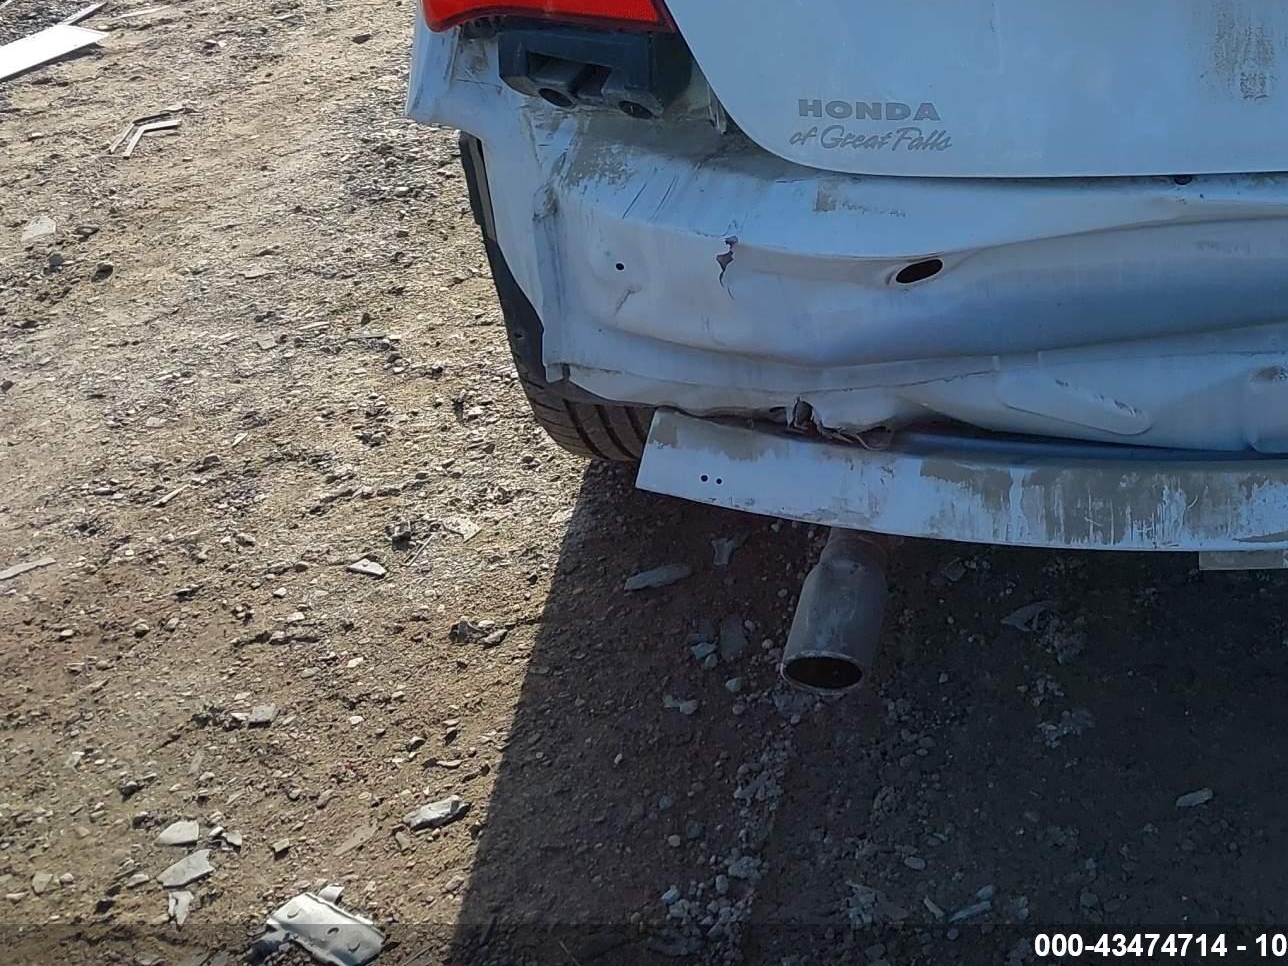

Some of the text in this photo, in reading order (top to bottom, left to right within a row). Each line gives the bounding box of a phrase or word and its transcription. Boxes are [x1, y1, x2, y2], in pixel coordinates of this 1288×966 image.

[798, 99, 941, 121] HONDA
[789, 124, 953, 152] of Great Falls
